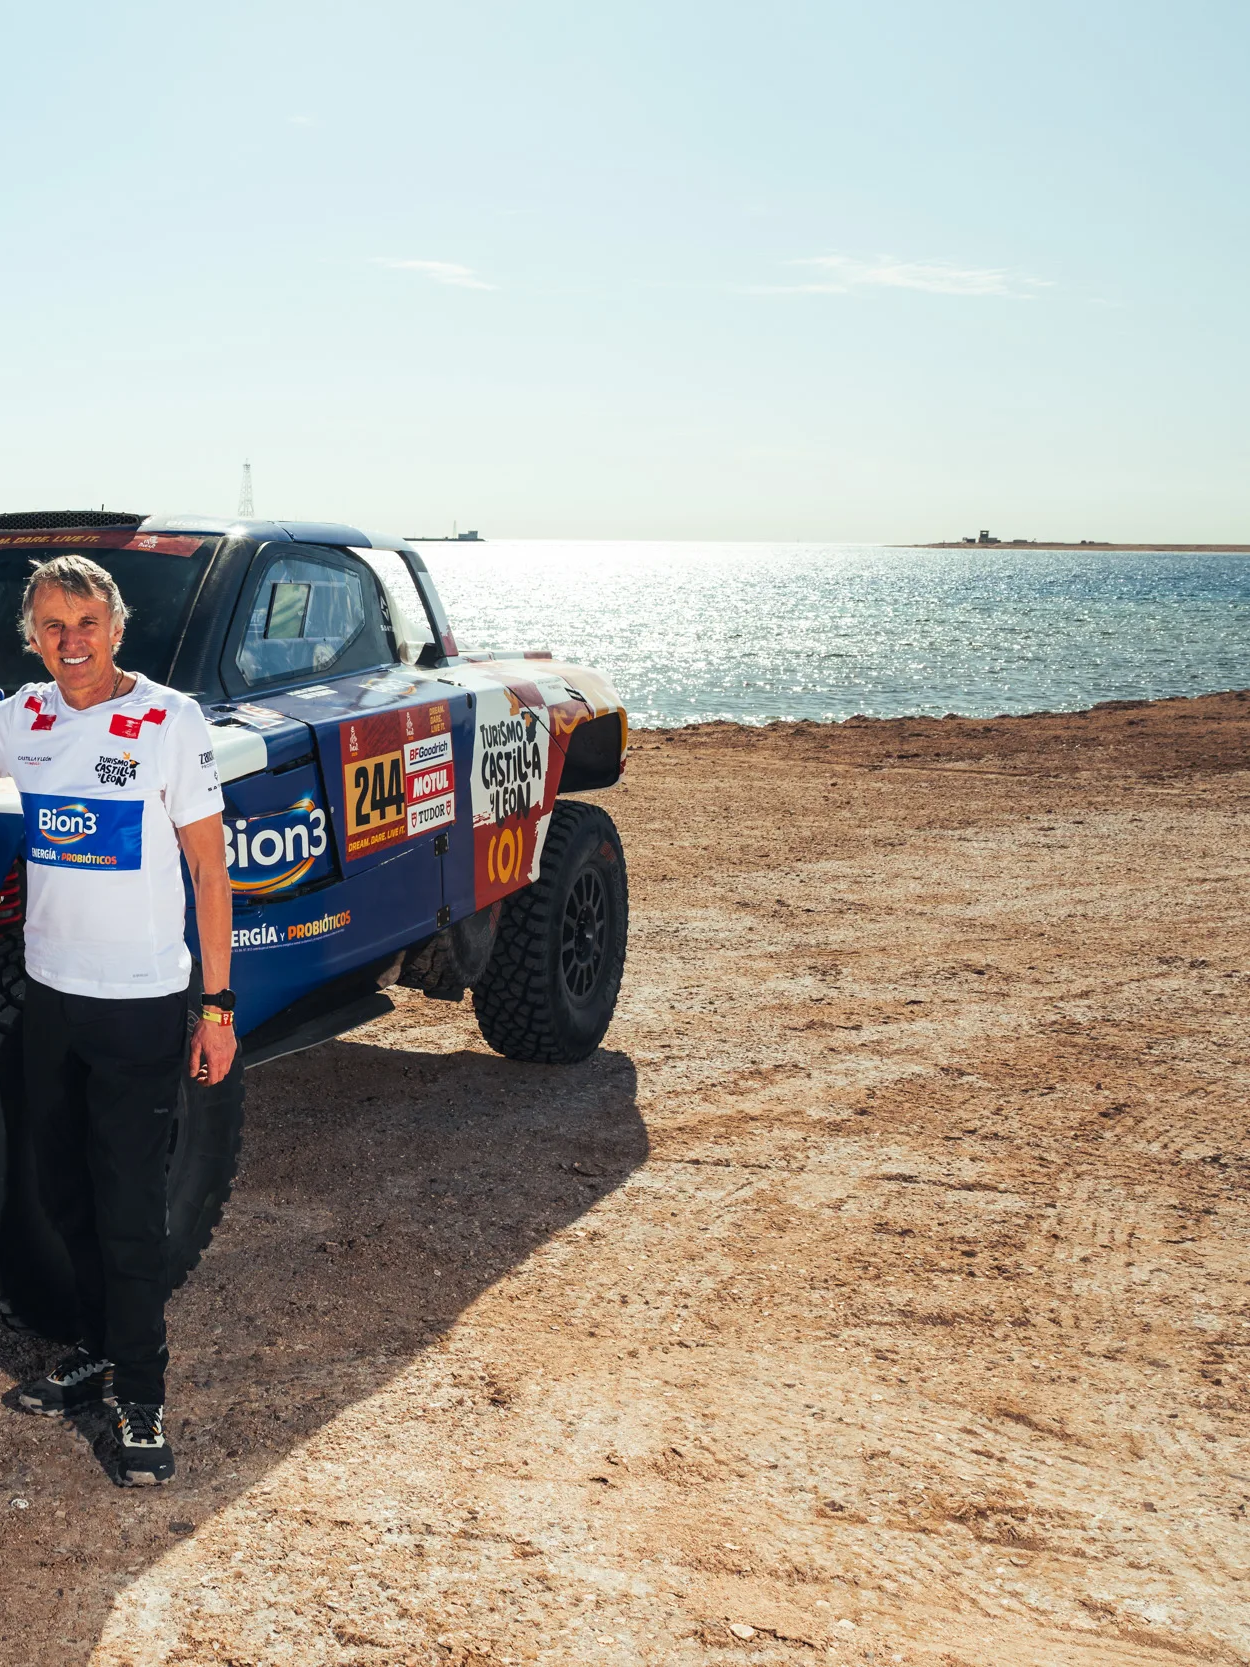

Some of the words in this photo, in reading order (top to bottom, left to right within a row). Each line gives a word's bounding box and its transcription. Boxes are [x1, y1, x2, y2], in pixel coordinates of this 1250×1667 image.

[480, 720, 523, 750] TURISMO
[99, 755, 128, 767] TURISMO
[410, 740, 448, 760] BFGoodrich
[95, 762, 136, 780] CASTILLA
[481, 740, 541, 789] CASTILLA
[355, 758, 405, 827] 244
[412, 769, 449, 799] MOTUL
[38, 808, 97, 834] Bion3
[418, 803, 445, 824] TUDOR
[348, 838, 370, 853] DREAM.
[61, 852, 117, 865] PROBIÓTICOS
[231, 923, 278, 948] ERGÍA
[280, 932, 285, 941] Y
[287, 910, 351, 941] PROBIÓTICOS
